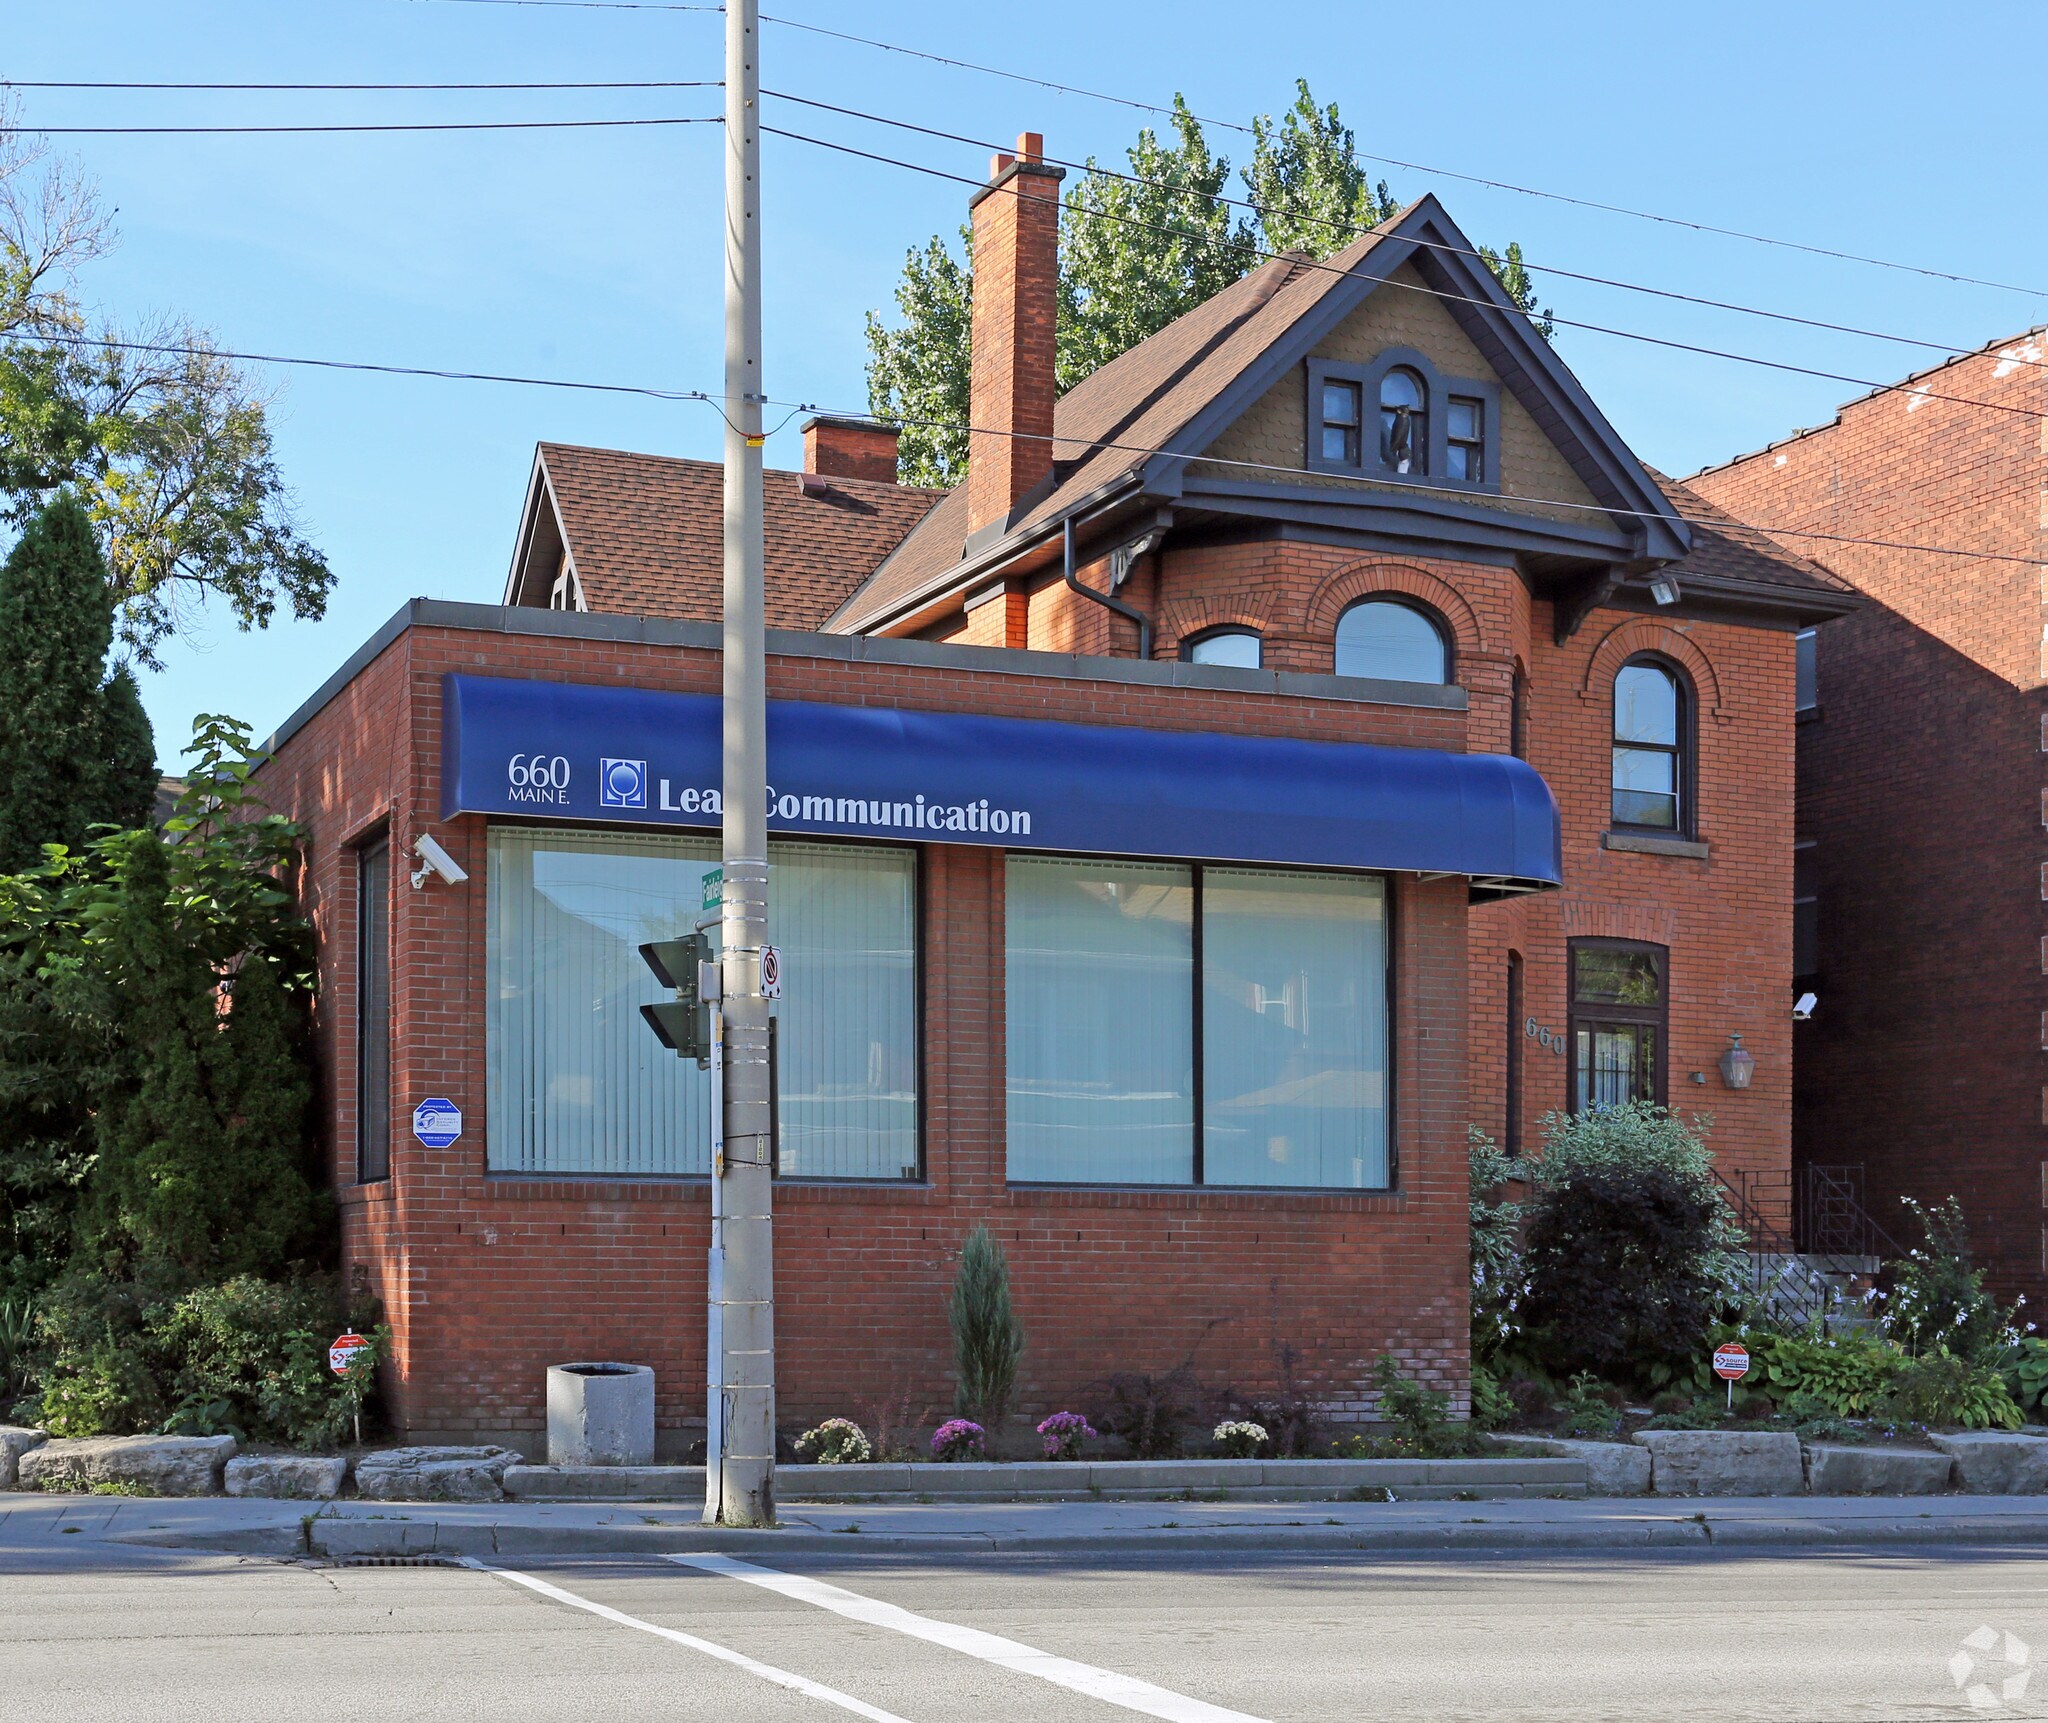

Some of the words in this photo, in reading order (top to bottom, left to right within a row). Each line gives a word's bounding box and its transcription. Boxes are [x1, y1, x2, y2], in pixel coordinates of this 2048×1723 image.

[508, 754, 571, 790] 660
[508, 787, 554, 804] MAIN
[558, 790, 571, 805] E.
[659, 778, 723, 814] Lea
[1526, 1016, 1565, 1055] 660
